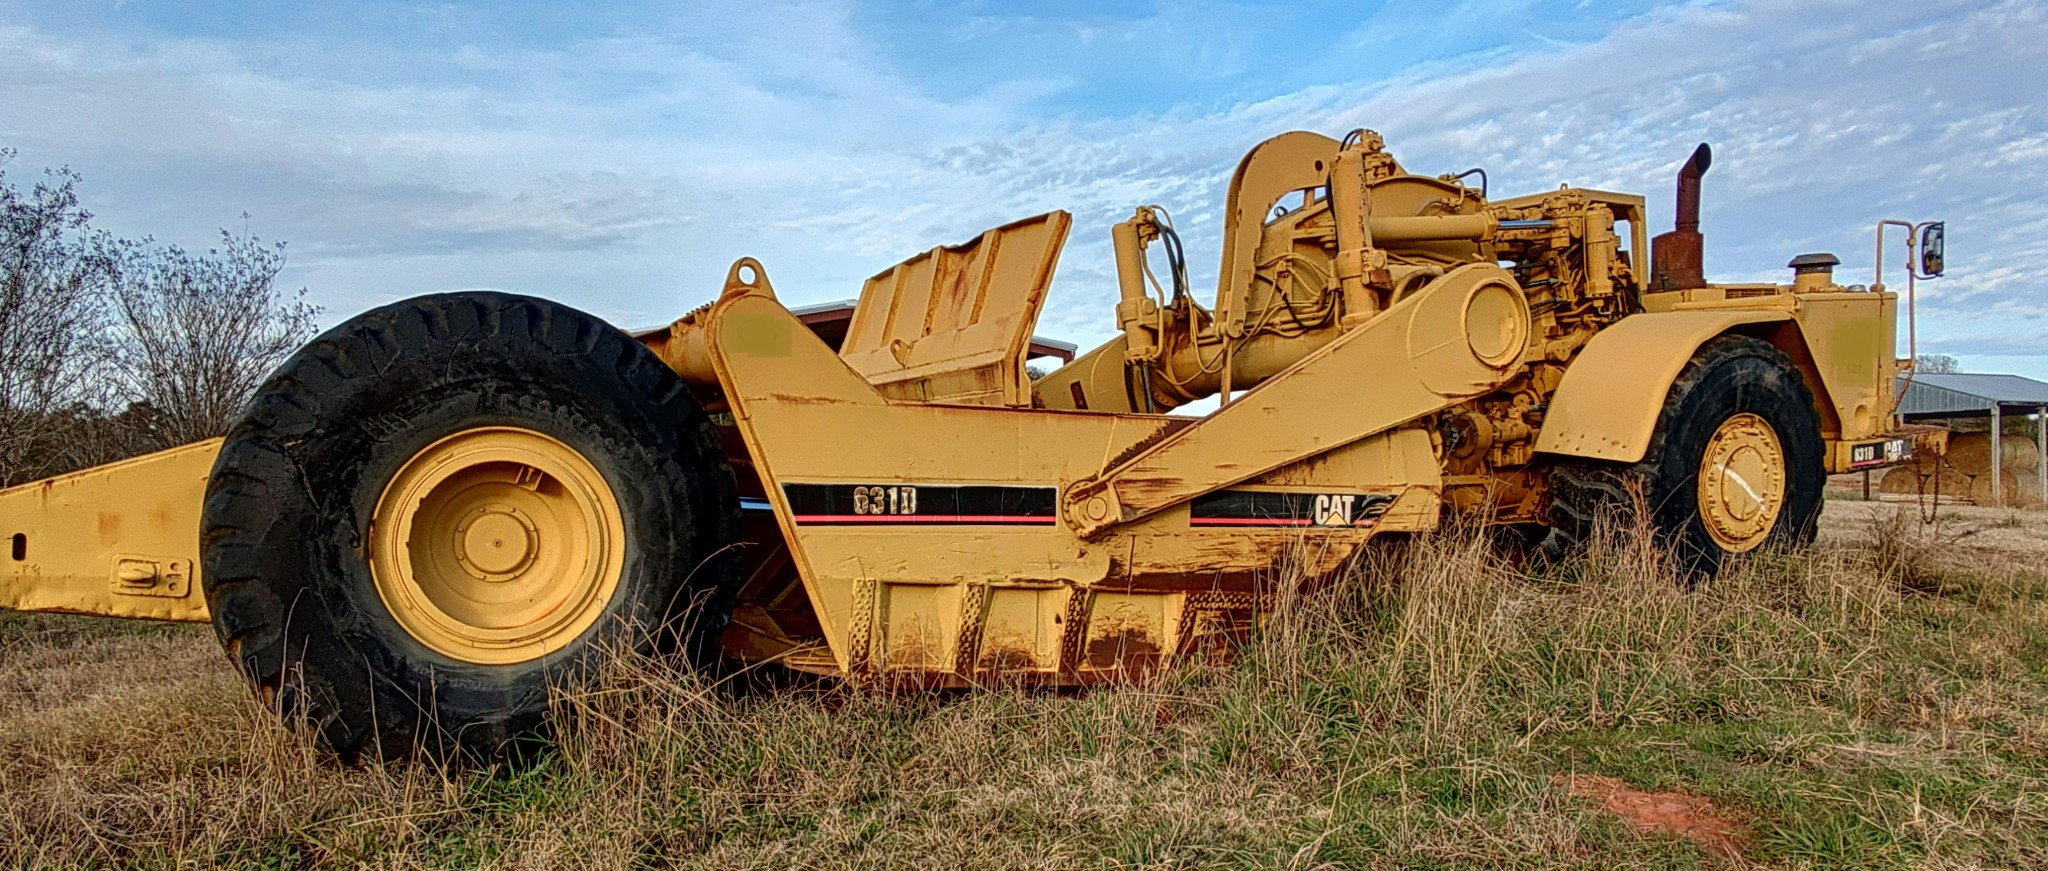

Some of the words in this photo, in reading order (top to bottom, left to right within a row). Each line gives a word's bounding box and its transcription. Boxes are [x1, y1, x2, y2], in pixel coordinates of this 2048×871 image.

[1854, 446, 1874, 462] 631D
[1884, 440, 1903, 461] CAT
[853, 486, 917, 515] 631D
[1315, 494, 1355, 525] CAT
